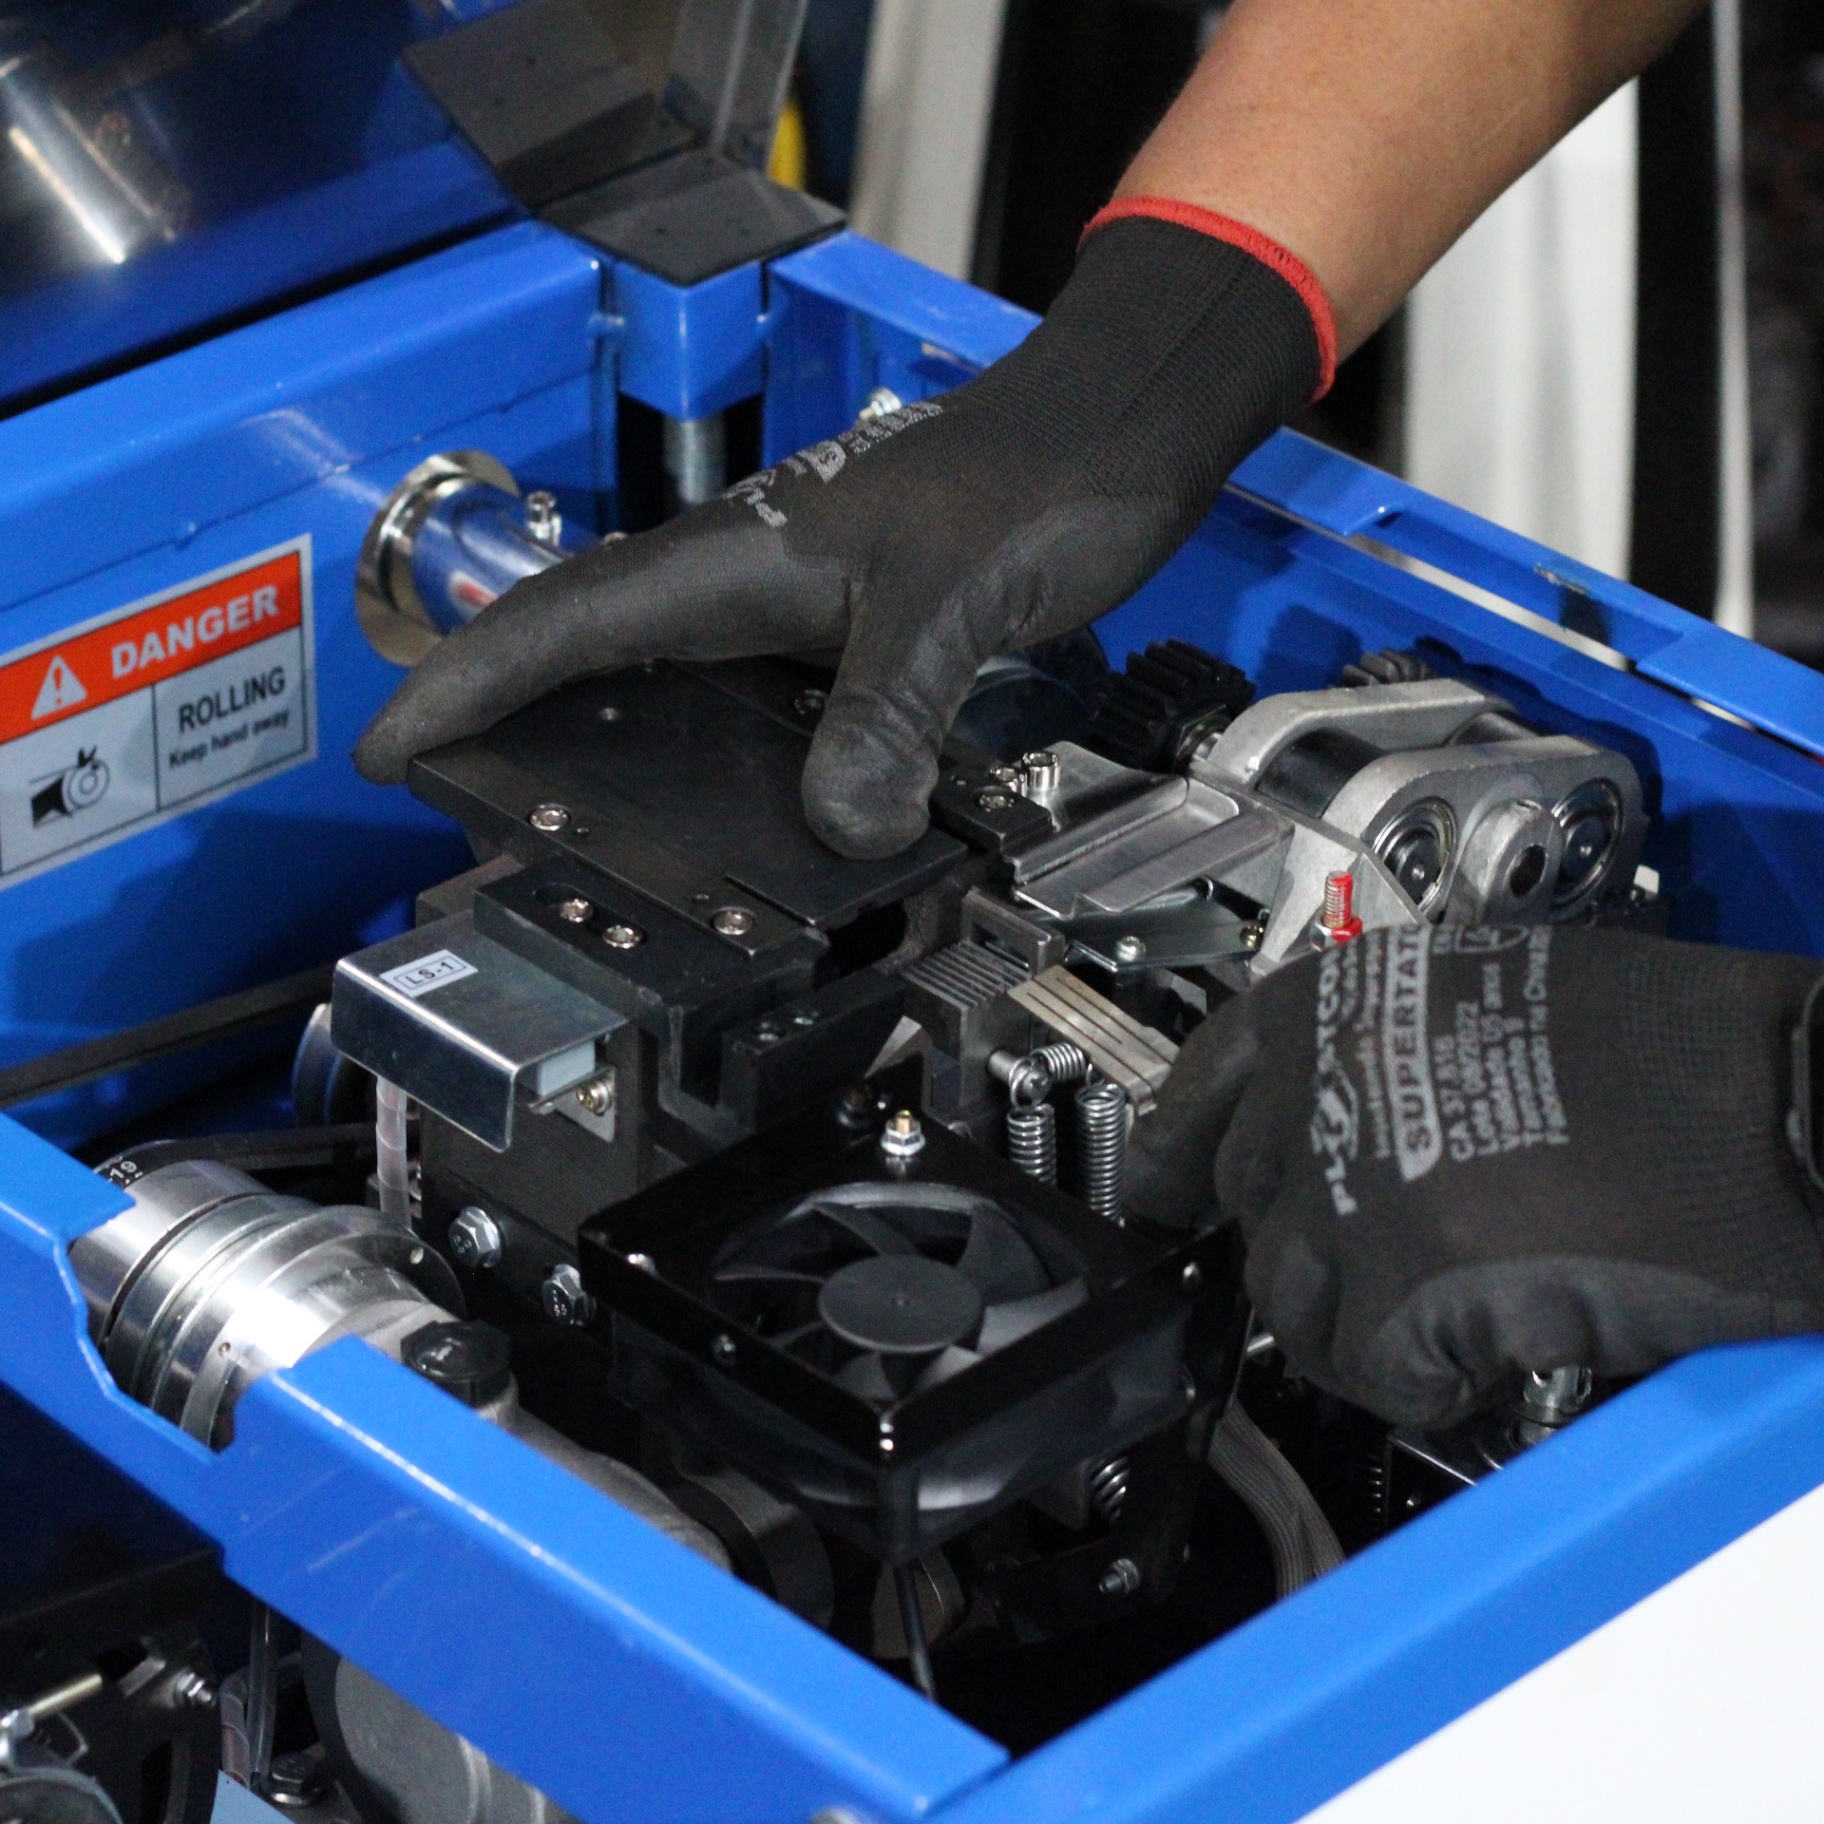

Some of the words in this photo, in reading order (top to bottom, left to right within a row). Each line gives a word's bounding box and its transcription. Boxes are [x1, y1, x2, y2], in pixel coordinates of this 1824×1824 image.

[111, 585, 279, 680] DANGER
[179, 666, 286, 734] ROLLING
[168, 742, 208, 769] Keep
[211, 722, 249, 751] hand
[252, 707, 290, 735] away
[405, 960, 456, 986] LS-1
[1448, 1120, 1476, 1162] CA
